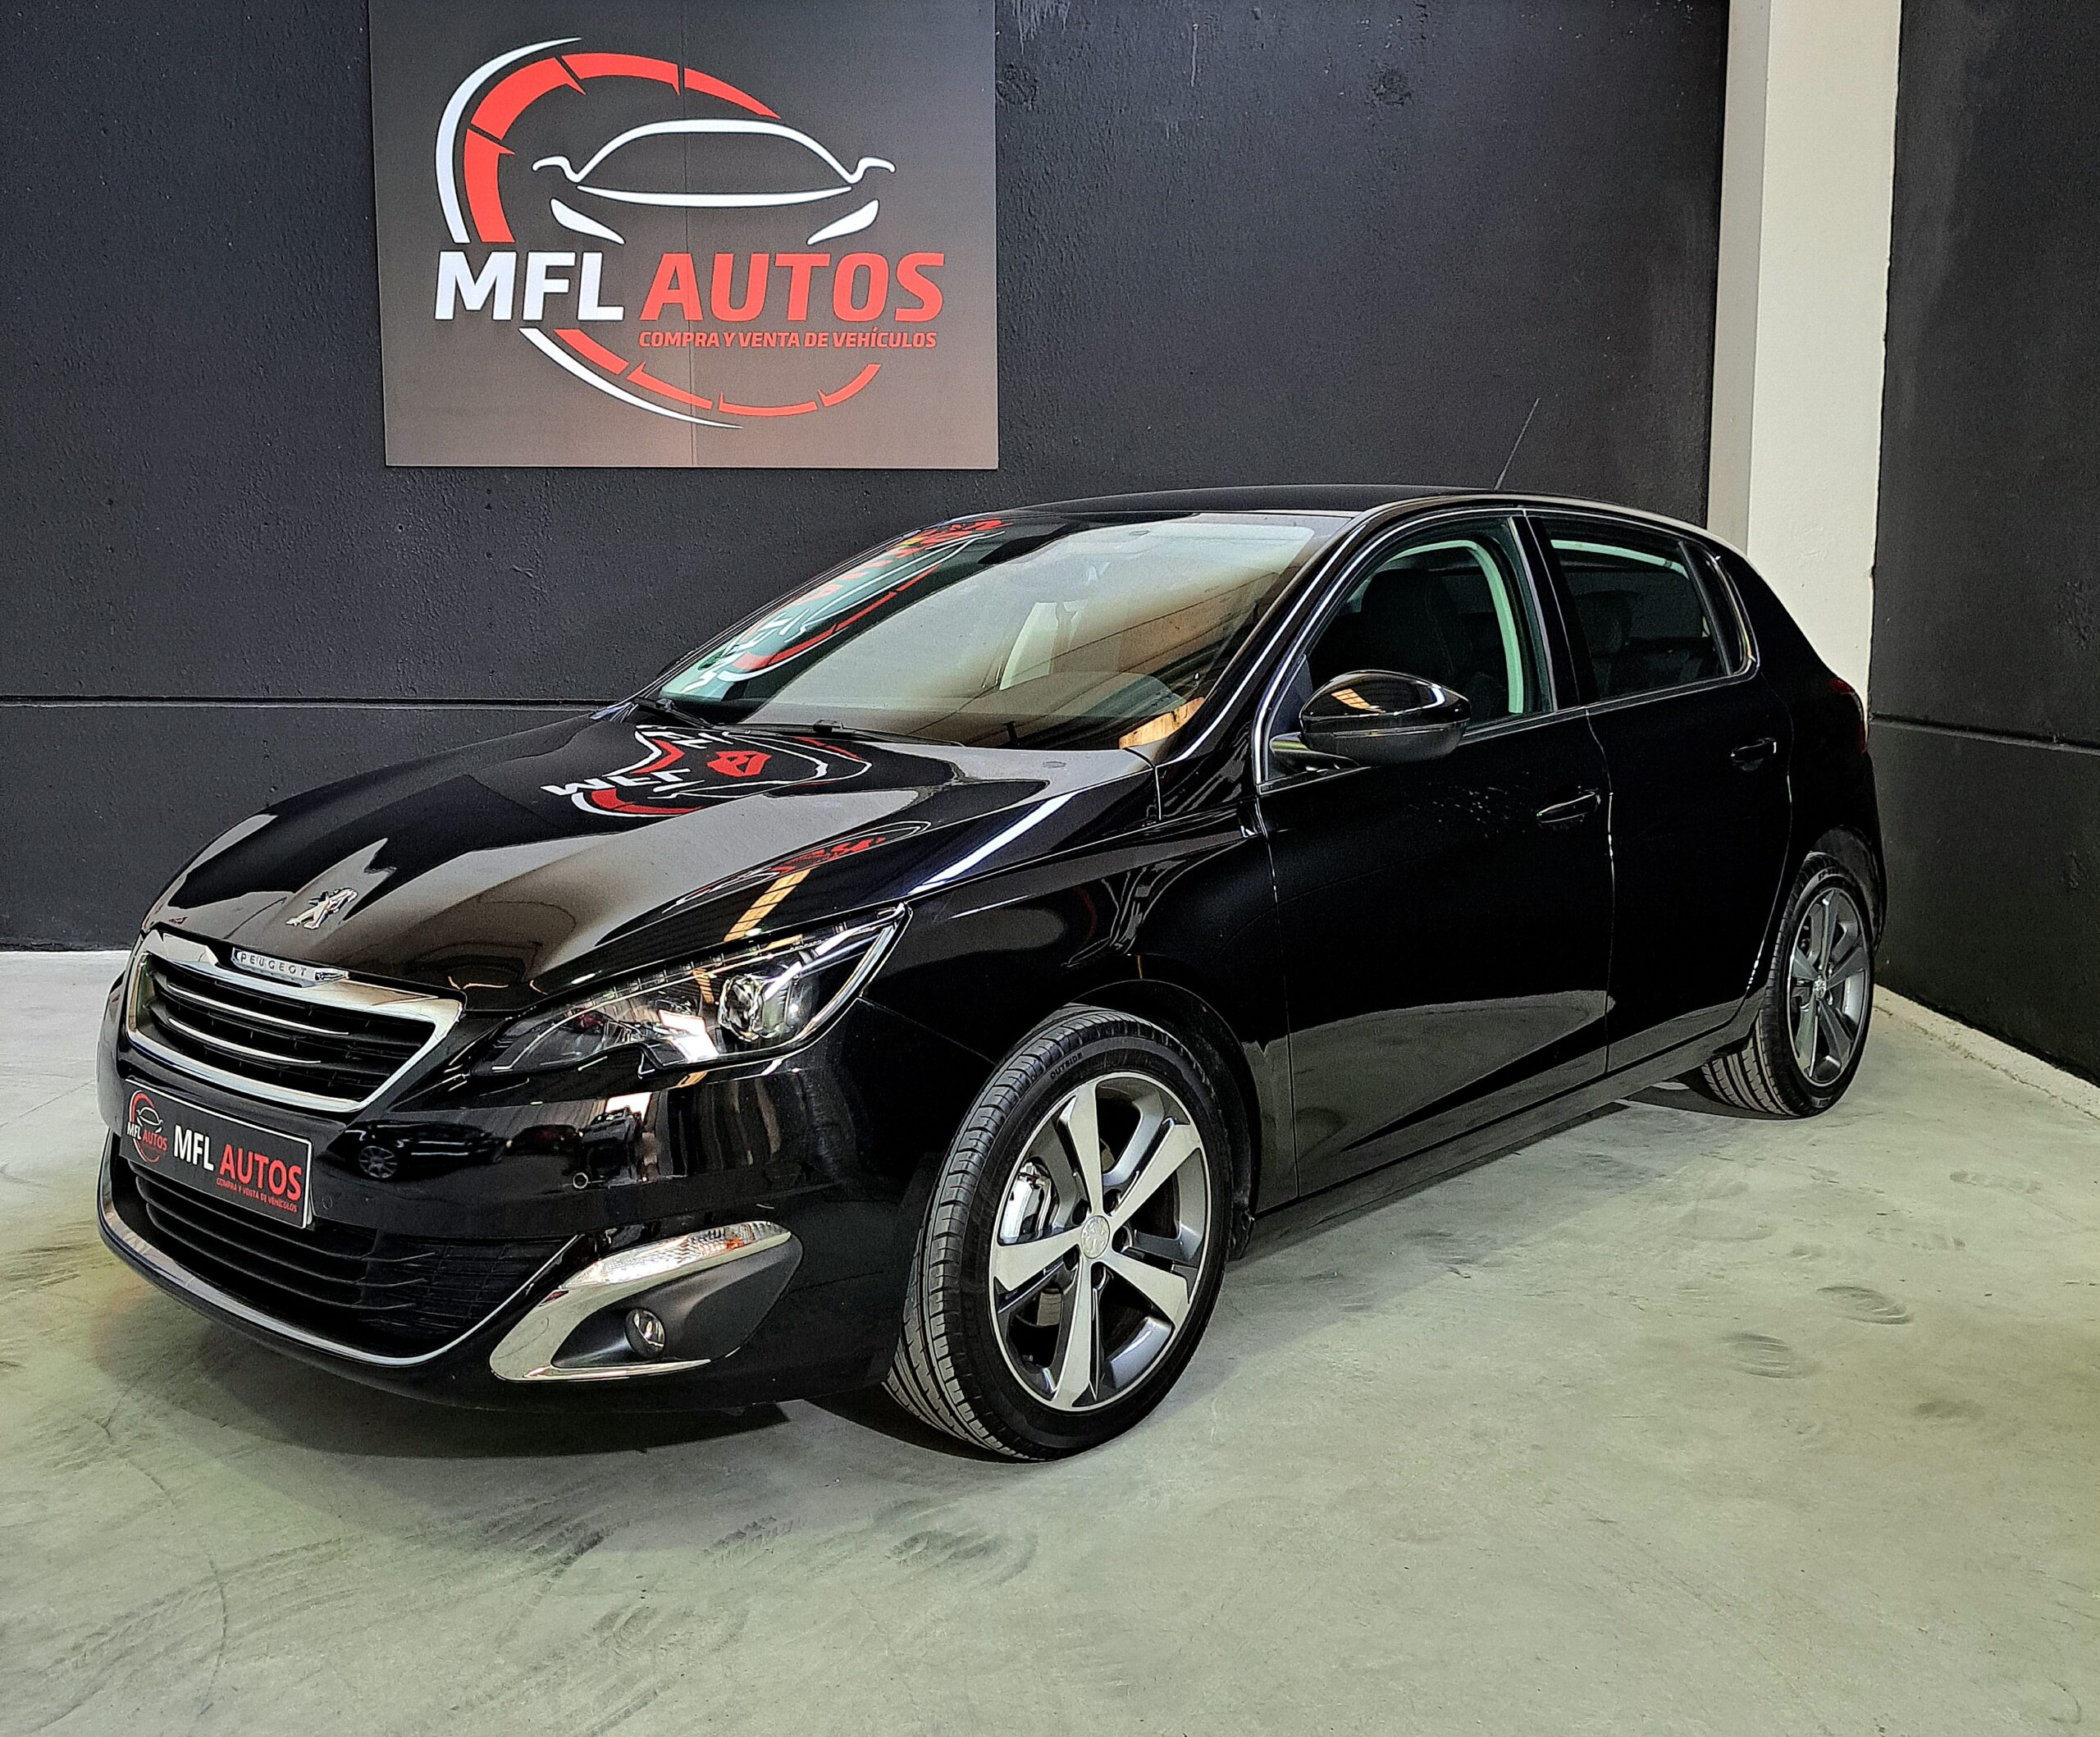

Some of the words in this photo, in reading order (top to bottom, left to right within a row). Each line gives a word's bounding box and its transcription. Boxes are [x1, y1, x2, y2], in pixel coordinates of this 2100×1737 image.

[435, 250, 624, 322] MFL
[639, 251, 945, 322] AUTOS
[638, 331, 720, 348] COMPRA
[724, 331, 737, 348] Y
[739, 331, 802, 348] VENTA
[804, 331, 829, 348] DE
[833, 327, 938, 349] VEHÍCULOS
[240, 953, 308, 976] PEUGEOT
[1051, 1052, 1083, 1079] OUTSIDE
[126, 1122, 142, 1140] MFL
[142, 1129, 168, 1151] AUTOS
[173, 1124, 214, 1172] MFL
[218, 1143, 303, 1202] AUTOS
